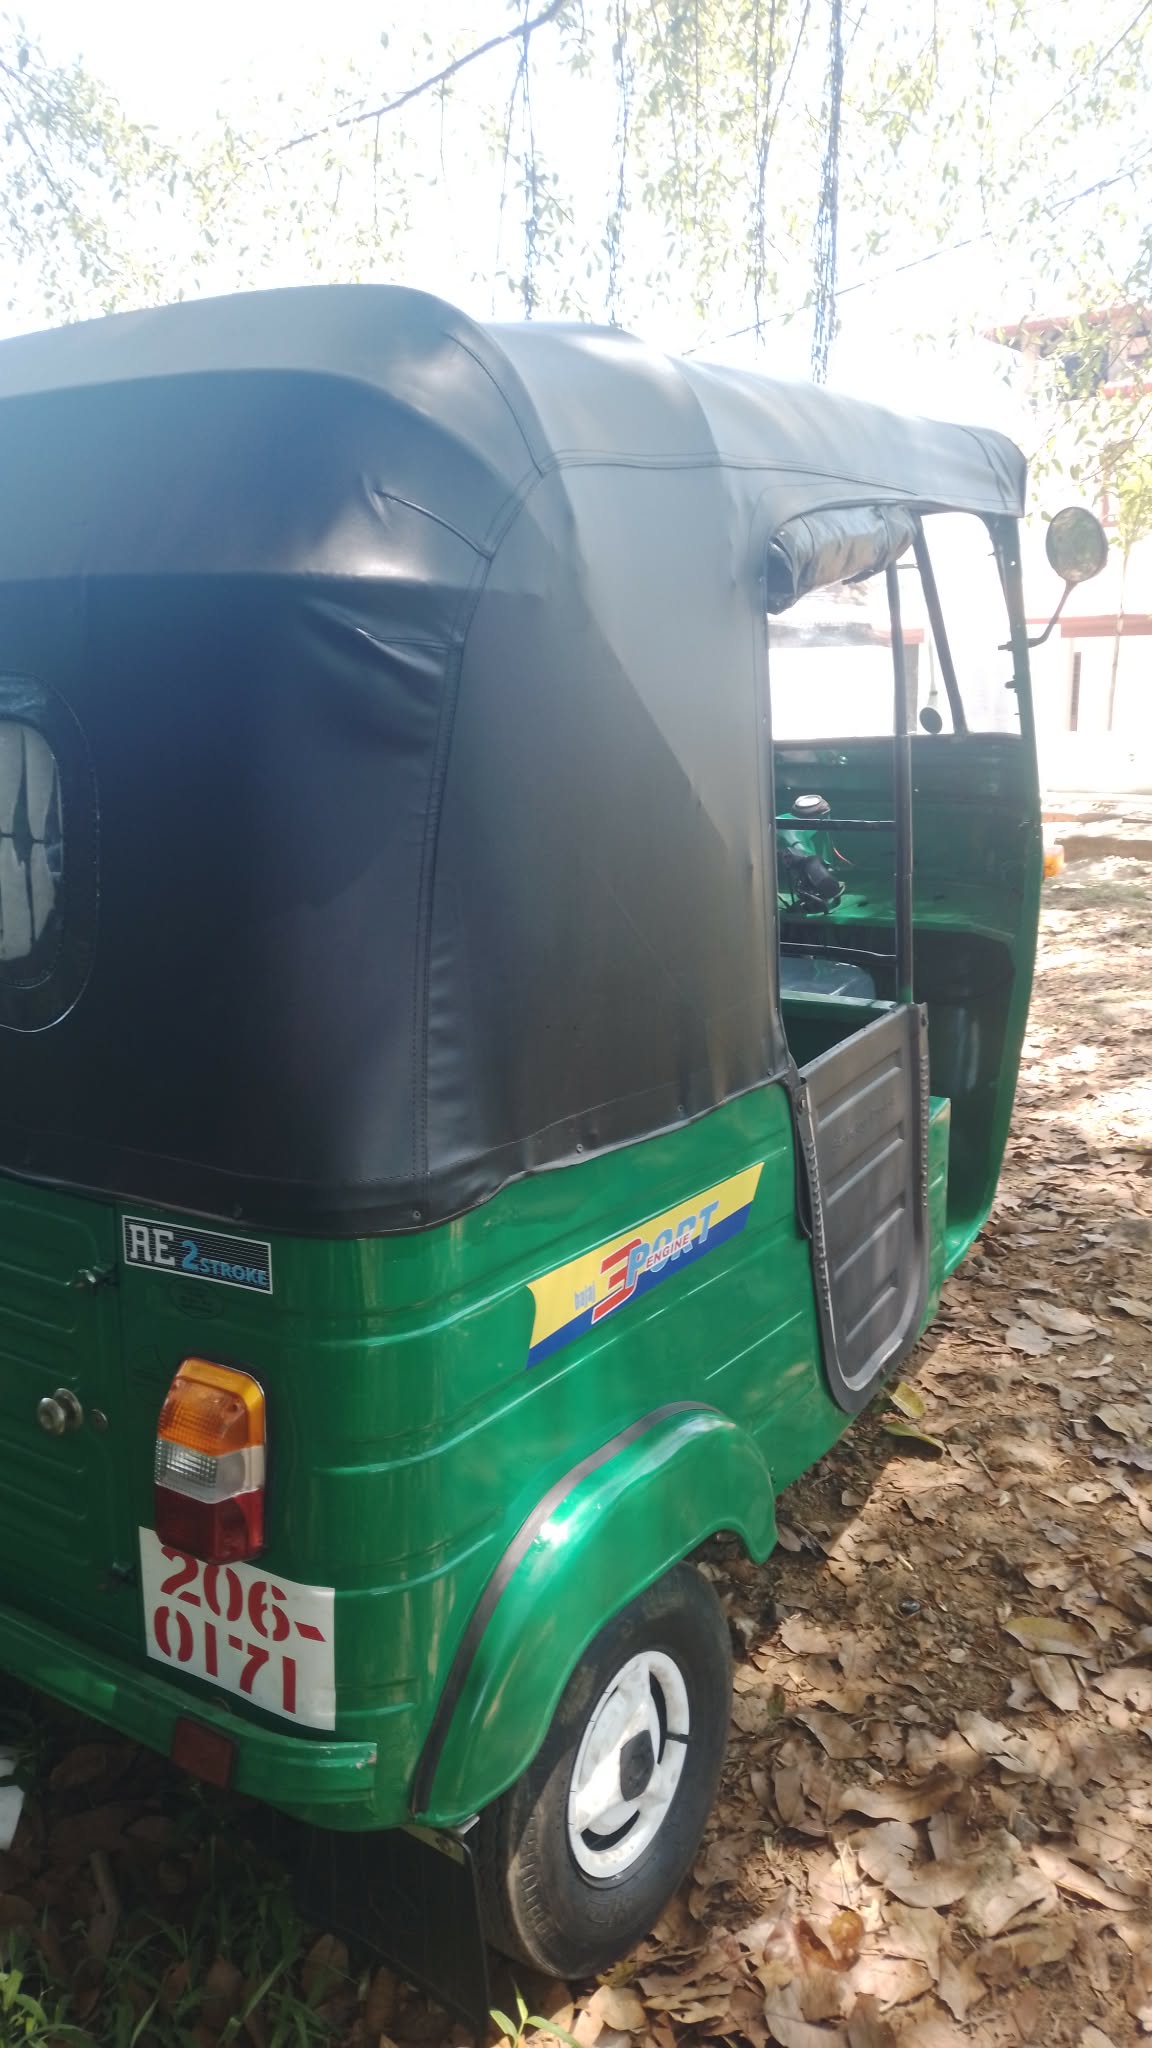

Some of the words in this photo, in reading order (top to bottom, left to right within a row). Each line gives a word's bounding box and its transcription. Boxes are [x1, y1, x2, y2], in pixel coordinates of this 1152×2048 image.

[129, 1224, 176, 1266] RE
[181, 1240, 199, 1270] 2
[200, 1257, 267, 1286] STROKE
[646, 1232, 690, 1269] ENGINE
[160, 1546, 326, 1642] 206-
